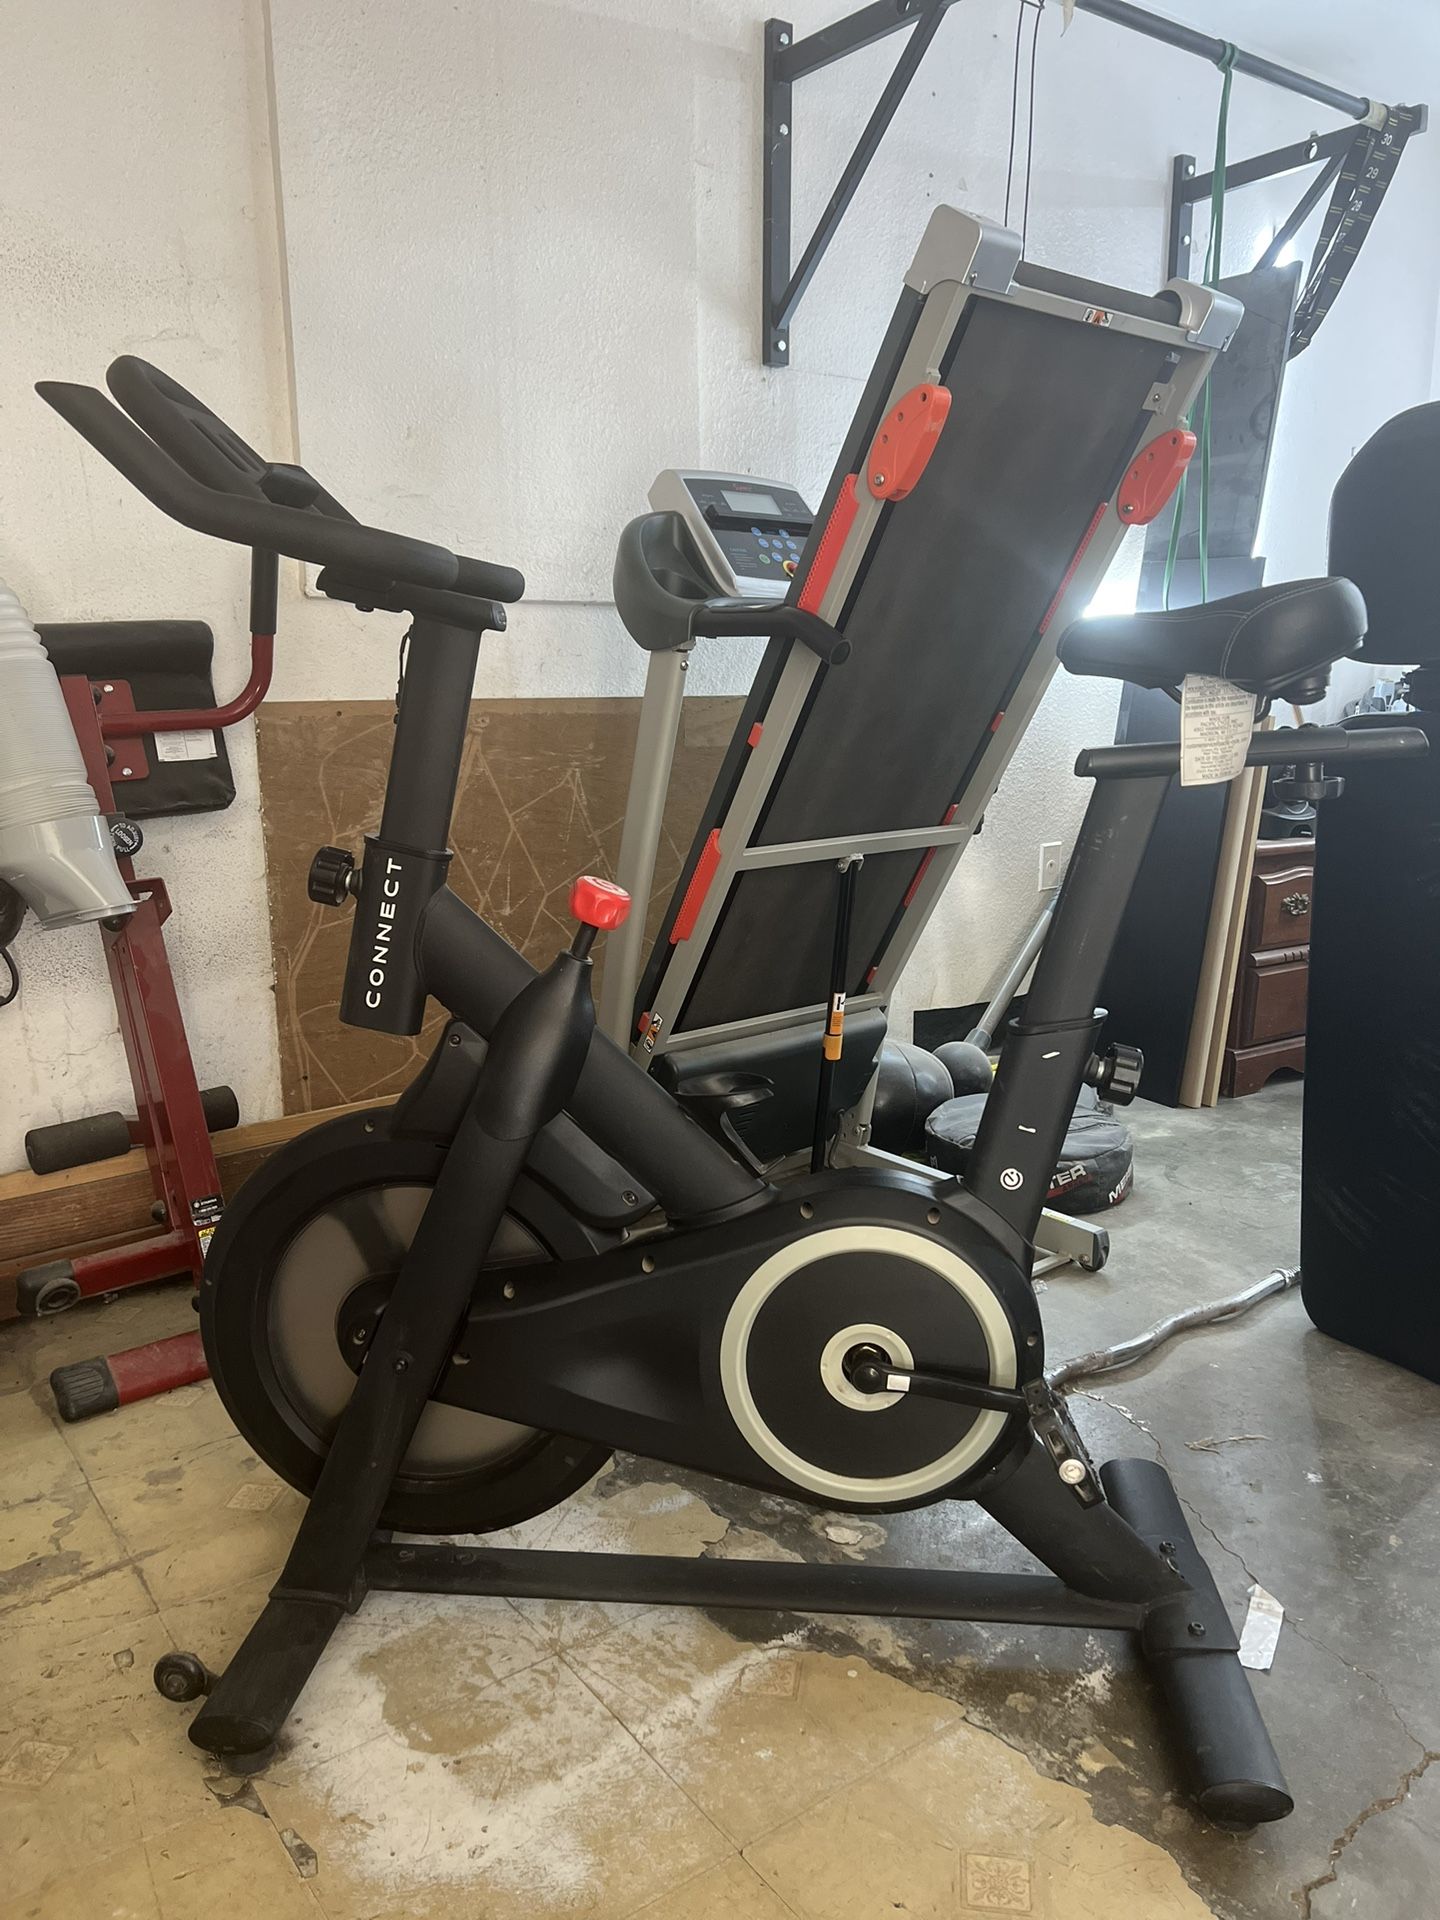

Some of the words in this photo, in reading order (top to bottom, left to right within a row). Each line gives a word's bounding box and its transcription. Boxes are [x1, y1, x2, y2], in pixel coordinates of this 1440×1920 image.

[1381, 133, 1393, 146] 30
[1366, 166, 1379, 179] 29
[114, 828, 134, 846] LOOSEN
[365, 857, 402, 1009] CONNECT
